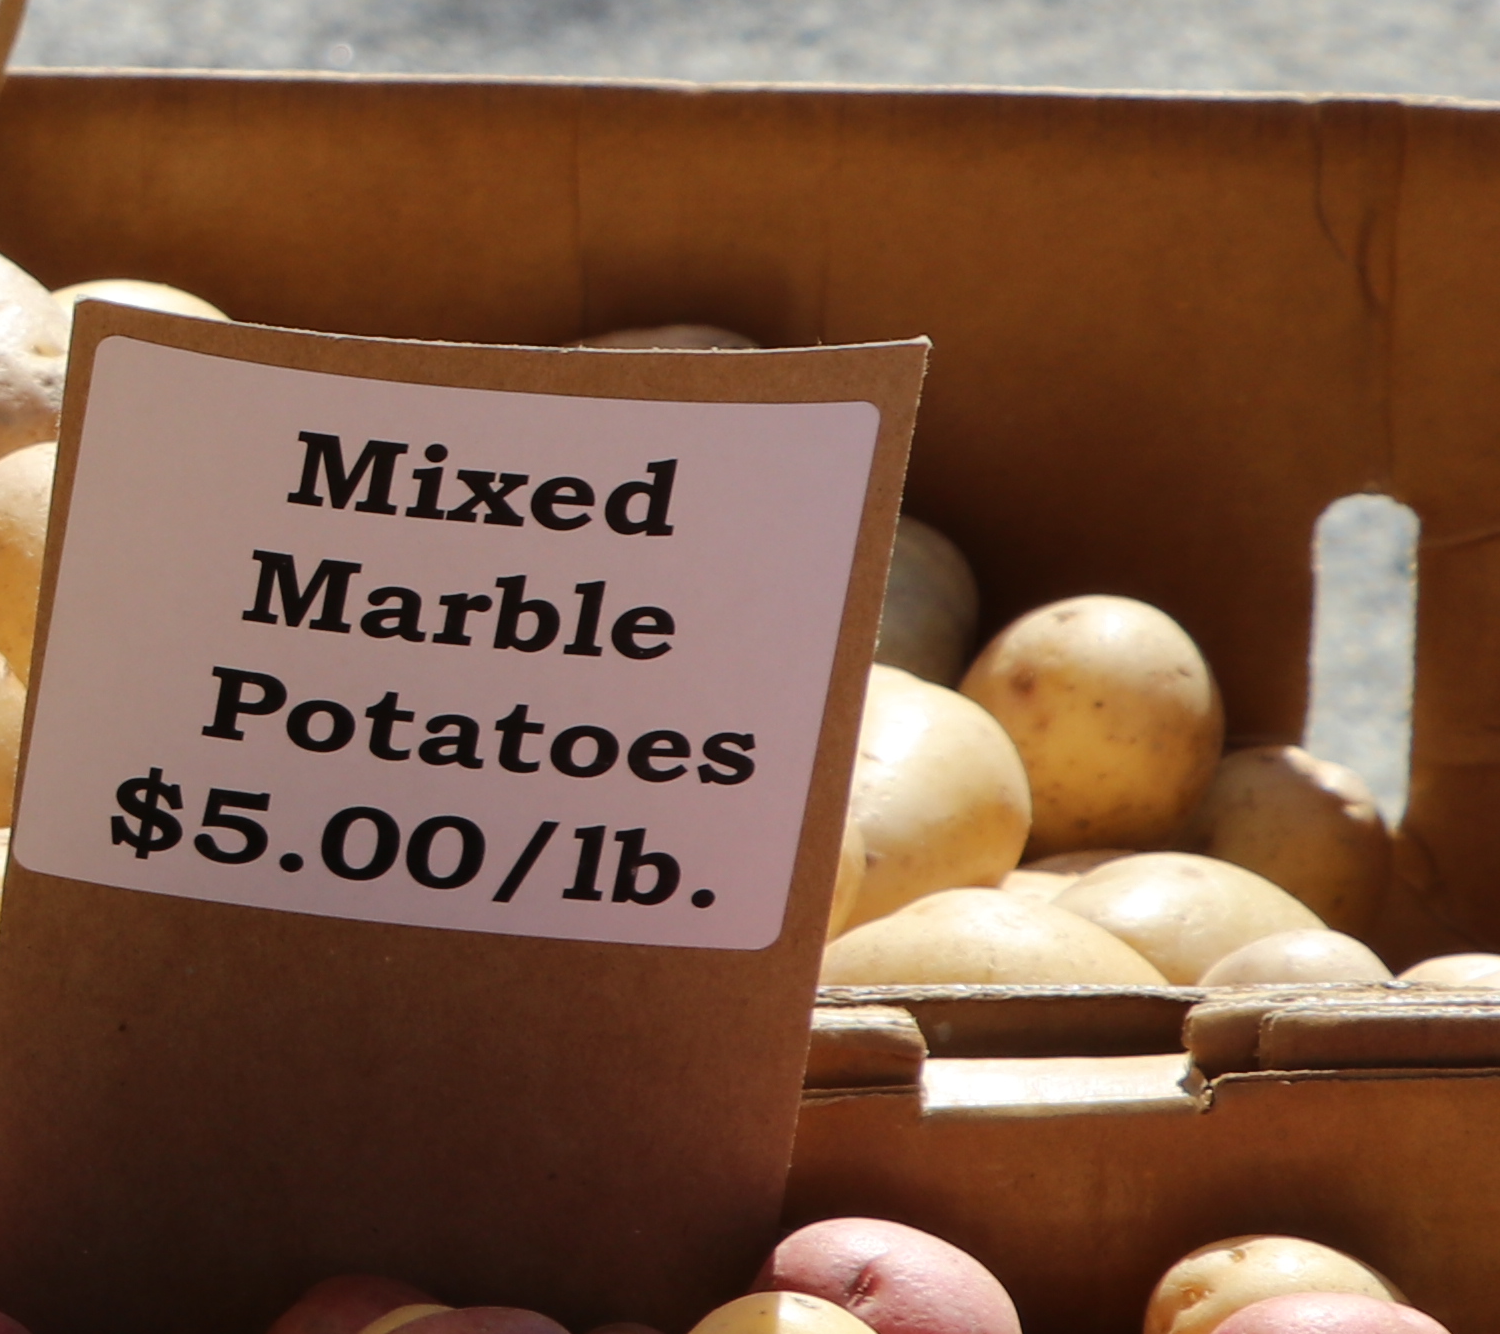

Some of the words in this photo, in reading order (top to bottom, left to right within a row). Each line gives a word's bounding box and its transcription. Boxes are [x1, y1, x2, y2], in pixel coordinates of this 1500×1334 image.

[286, 430, 678, 537] Mixed
[241, 549, 675, 661] Marble
[201, 666, 756, 786] Potatoes
[110, 766, 717, 909] $5.00/lb.
